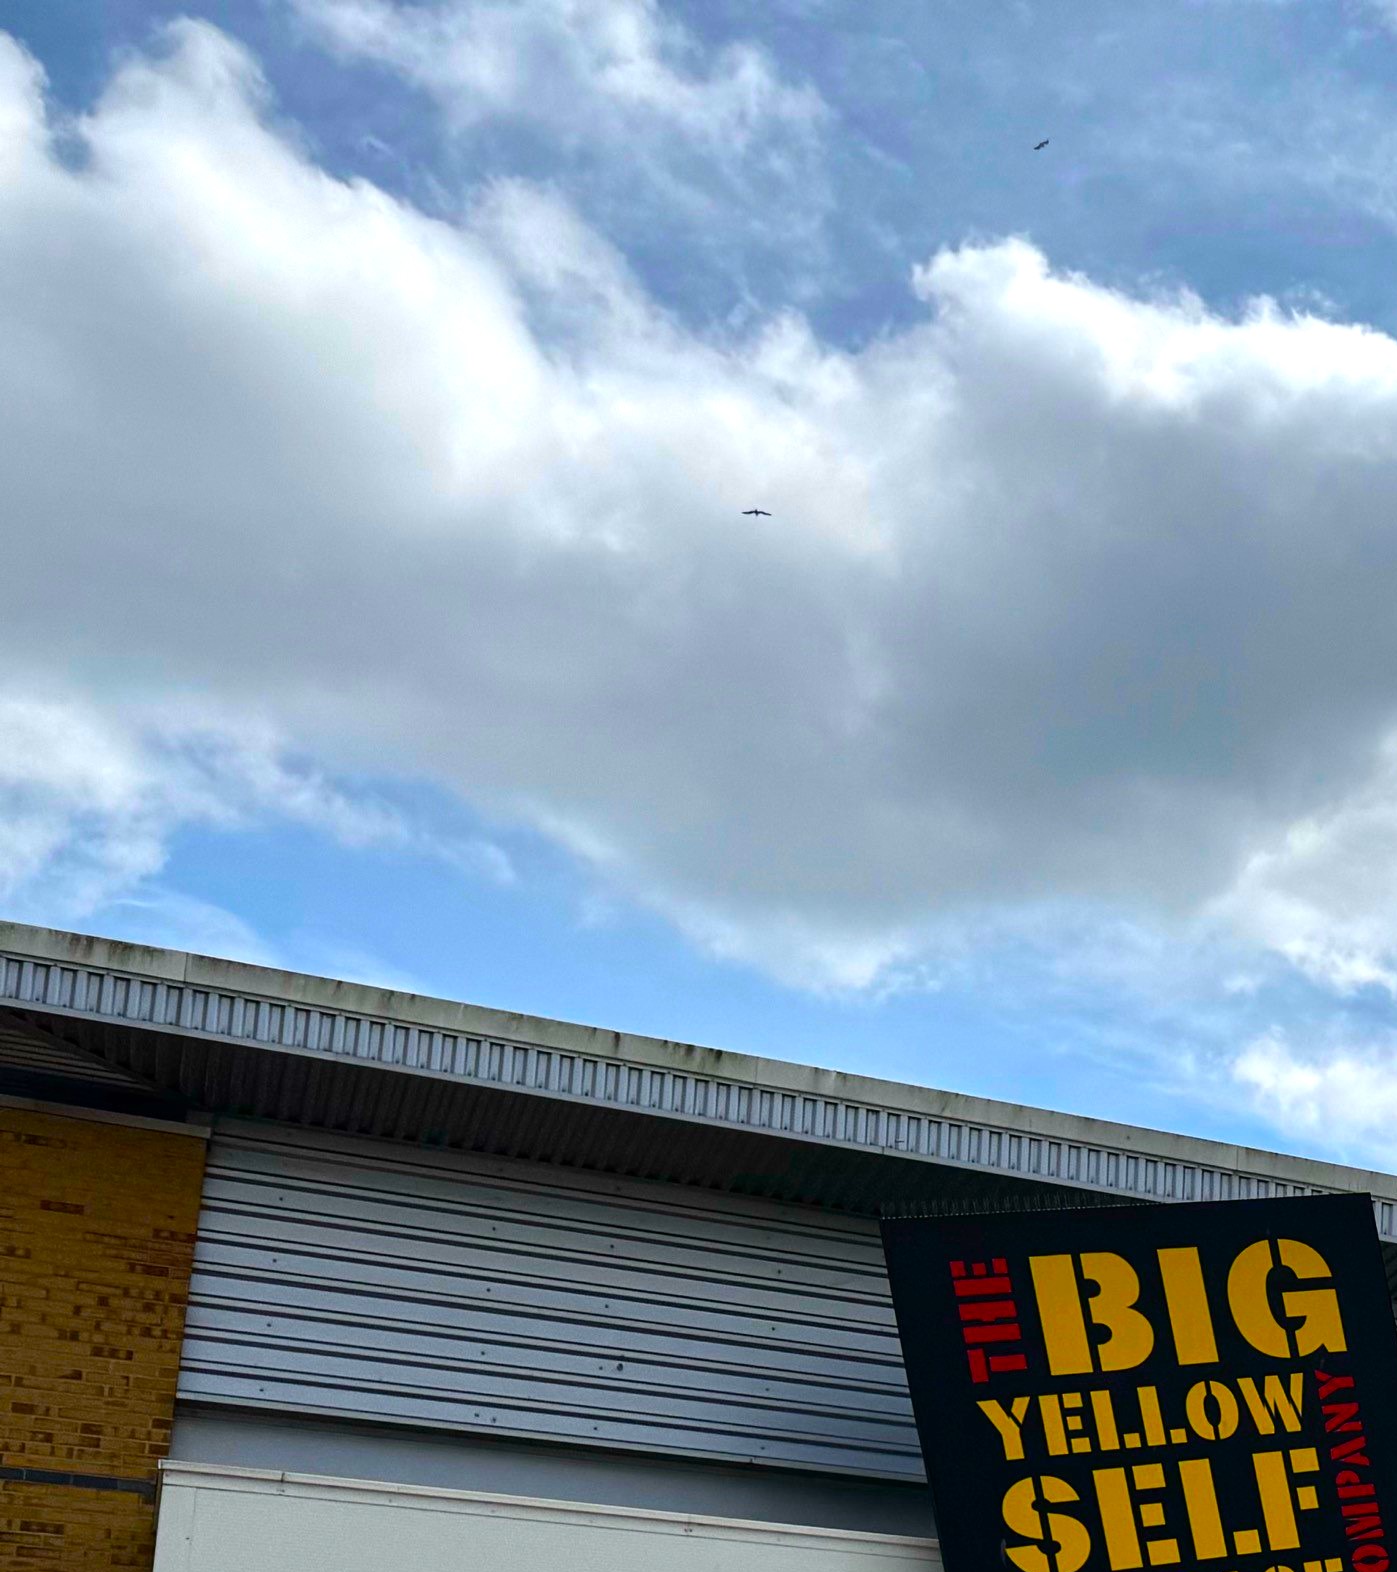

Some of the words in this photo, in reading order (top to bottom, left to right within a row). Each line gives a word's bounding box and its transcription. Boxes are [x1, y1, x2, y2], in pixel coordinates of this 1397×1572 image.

[949, 1257, 1028, 1384] THE
[1029, 1237, 1348, 1376] BIG
[975, 1372, 1304, 1461] YELLOW
